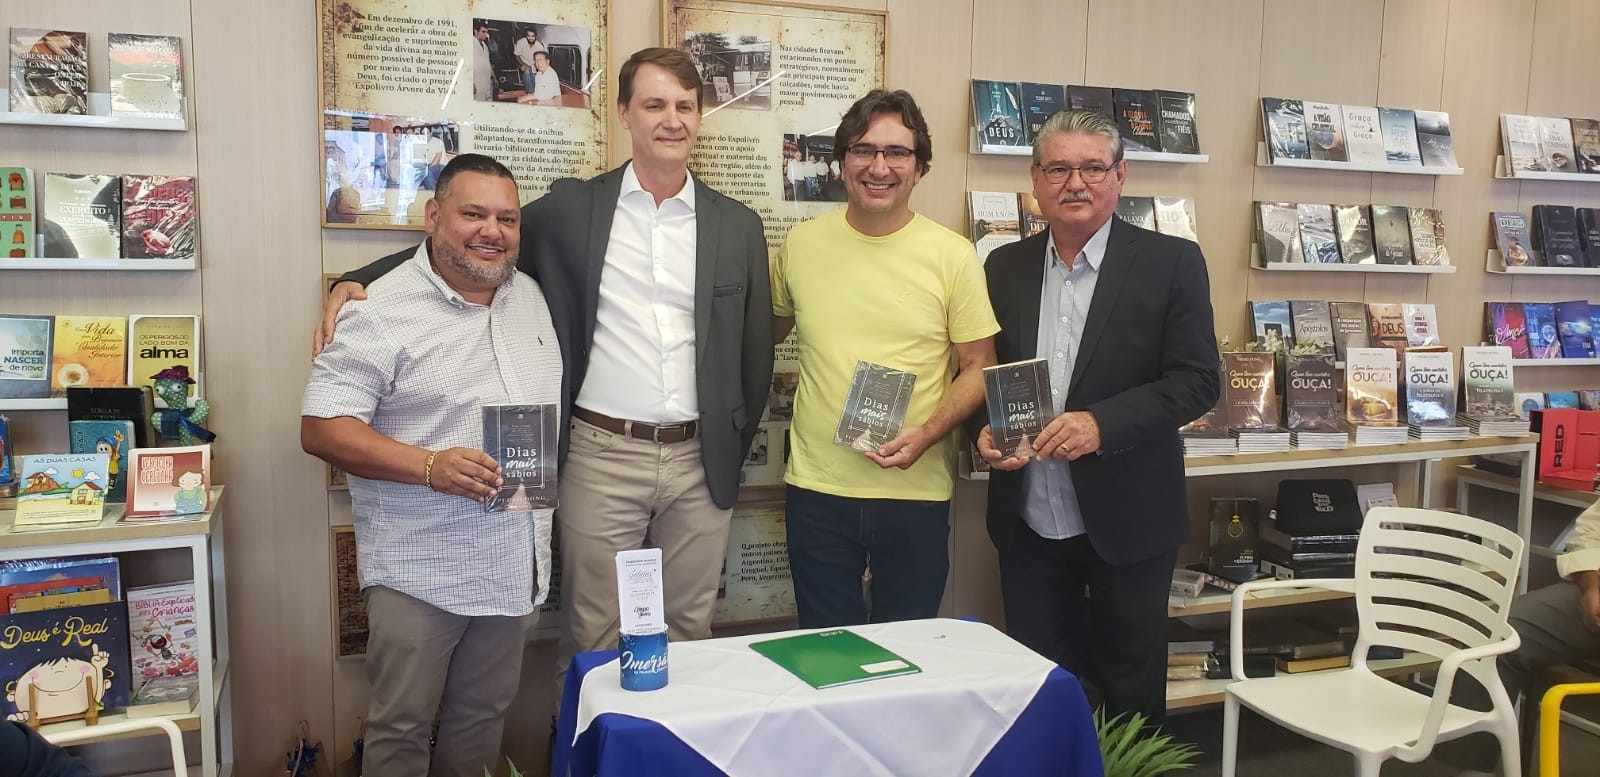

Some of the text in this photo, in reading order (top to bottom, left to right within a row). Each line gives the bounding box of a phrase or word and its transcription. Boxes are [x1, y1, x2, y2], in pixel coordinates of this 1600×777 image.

[383, 14, 422, 24] dezembro
[437, 19, 457, 28] 1991,
[360, 22, 372, 30] fim
[386, 26, 418, 34] acelerar
[428, 28, 445, 36] obra
[342, 32, 458, 46] evangelização suprimento
[346, 52, 379, 60] número
[394, 46, 420, 54] divina
[416, 66, 446, 75] Palavra
[357, 72, 380, 81] Deus,
[382, 73, 392, 81] foi
[394, 74, 420, 82] criado
[793, 73, 824, 81] principais
[356, 82, 394, 91] Expolivro
[396, 84, 424, 93] Árvore
[801, 91, 847, 100] movimentação
[996, 104, 1002, 113] A
[1350, 112, 1372, 123] Graça
[474, 124, 525, 134] Utilizando-se
[538, 128, 564, 136] ônibus
[988, 127, 1014, 138] DEUS
[1354, 131, 1373, 140] Graça
[474, 134, 516, 143] adaptados,
[518, 136, 572, 146] transformados
[547, 148, 579, 156] começou
[522, 156, 550, 164] cidades
[563, 158, 584, 166] Brasil
[720, 162, 744, 170] região,
[85, 322, 115, 335] Vida
[1382, 322, 1404, 334] DEUS
[12, 348, 44, 357] importa
[140, 346, 189, 359] alma
[4, 356, 44, 365] NASCER
[1291, 370, 1304, 380] Quem
[1352, 372, 1392, 384] OUÇA!
[1411, 374, 1448, 386] OUÇA!
[1470, 370, 1508, 382] OUÇA!
[1292, 378, 1332, 392] OUÇA!
[864, 397, 889, 411] Dias
[1008, 402, 1034, 412] Dias
[860, 407, 888, 420] mais
[1009, 410, 1036, 422] mais
[858, 416, 884, 428] sábios
[1010, 421, 1037, 430] sábios
[506, 446, 537, 458] Dias
[1554, 424, 1564, 468] RED
[506, 458, 536, 470] mais
[506, 469, 537, 478] sábios
[161, 596, 194, 606] Explicad
[152, 606, 194, 618] Crianças
[0, 616, 109, 650] Deus é Real
[622, 650, 668, 674] Imersã
